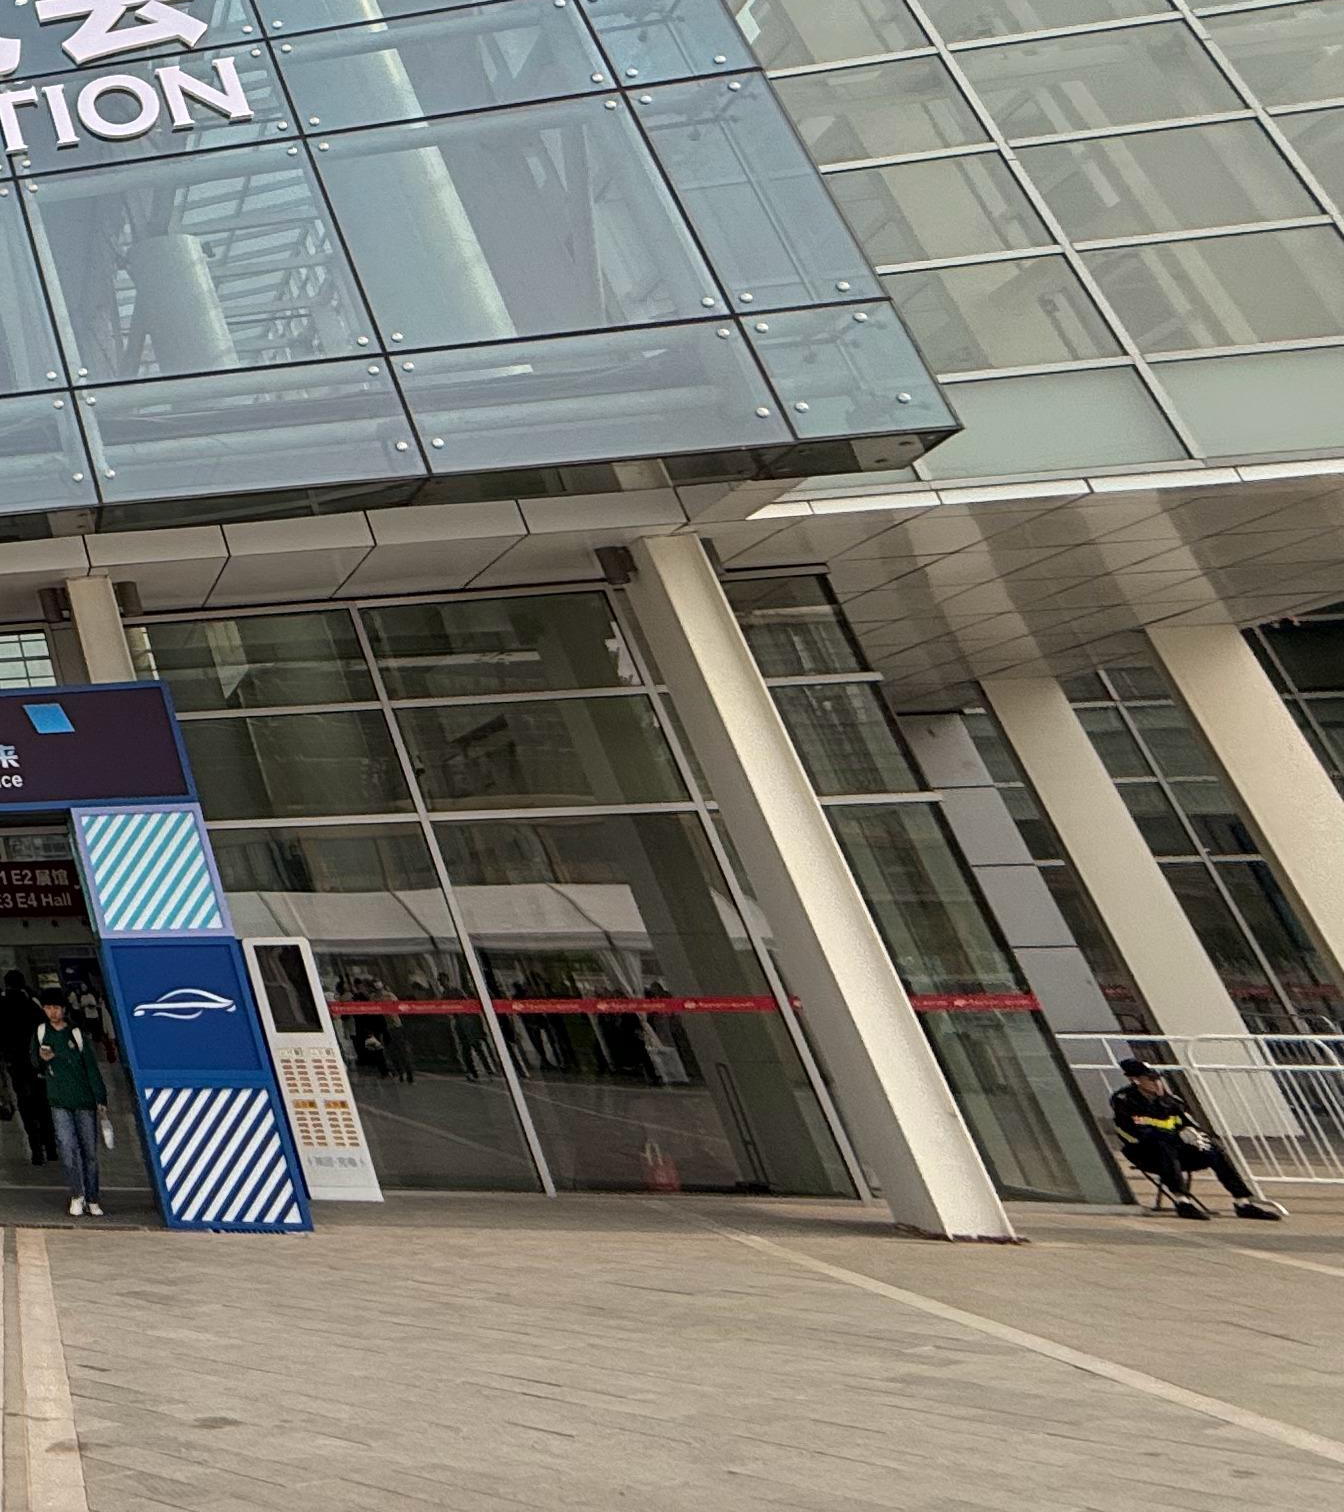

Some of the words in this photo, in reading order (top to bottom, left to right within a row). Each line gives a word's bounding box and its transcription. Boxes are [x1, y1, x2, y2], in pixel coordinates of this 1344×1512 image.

[10, 869, 33, 885] E2
[16, 892, 38, 908] E4
[40, 891, 72, 907] Hall
